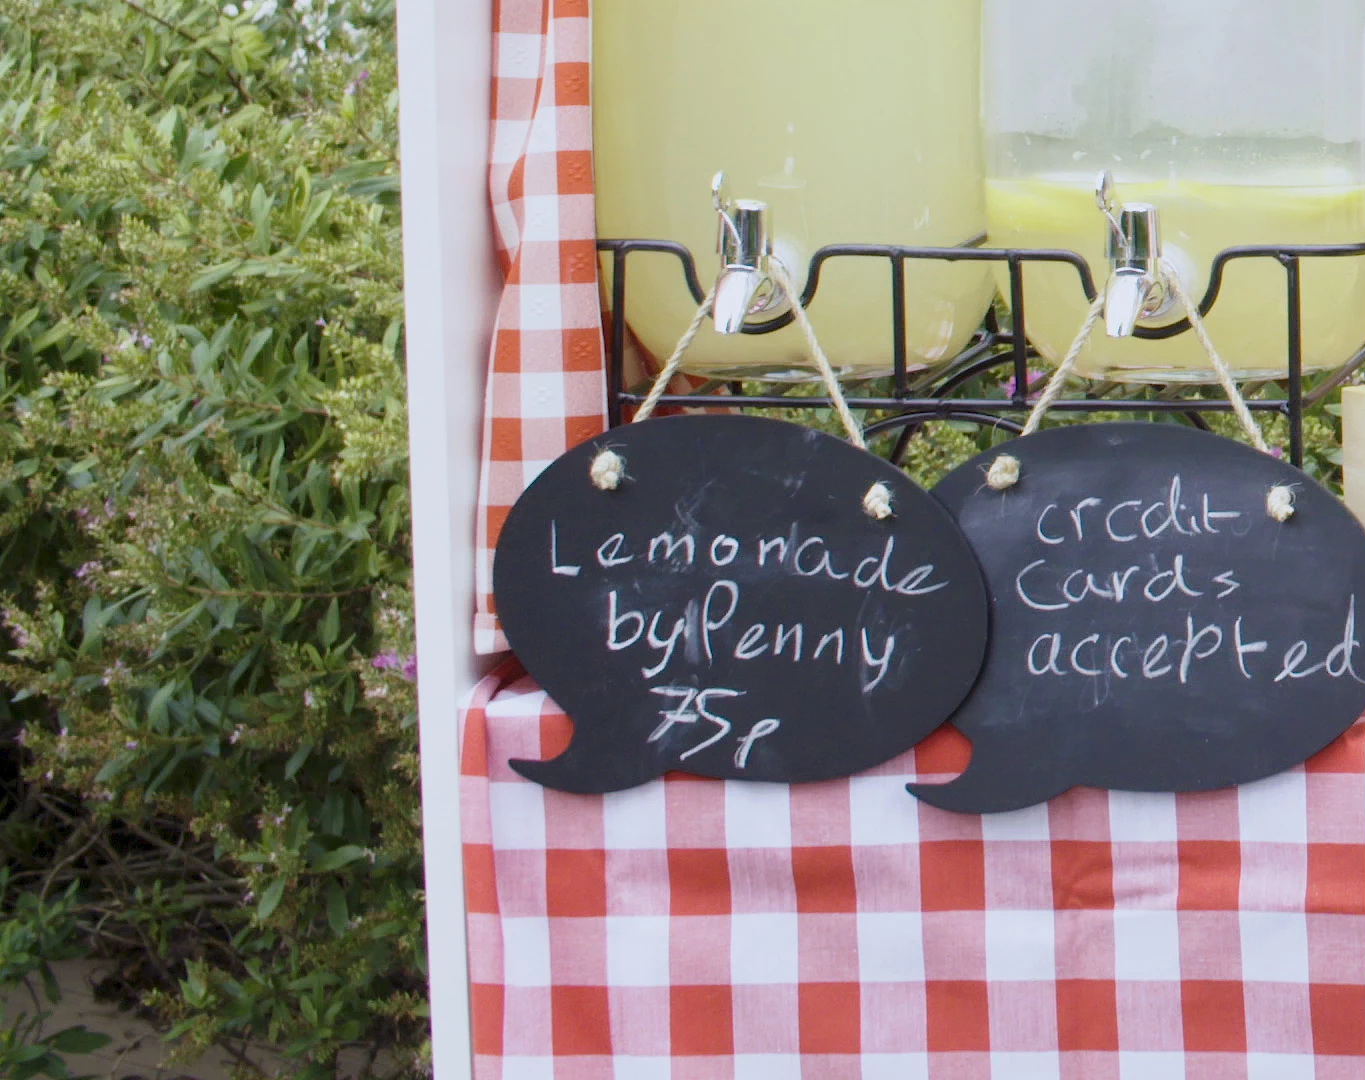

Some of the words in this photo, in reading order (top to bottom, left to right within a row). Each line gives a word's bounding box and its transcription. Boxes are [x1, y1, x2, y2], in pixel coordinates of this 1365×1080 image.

[550, 520, 949, 595] Lemonade
[702, 580, 896, 693] Penny
[646, 687, 780, 768] 75p
